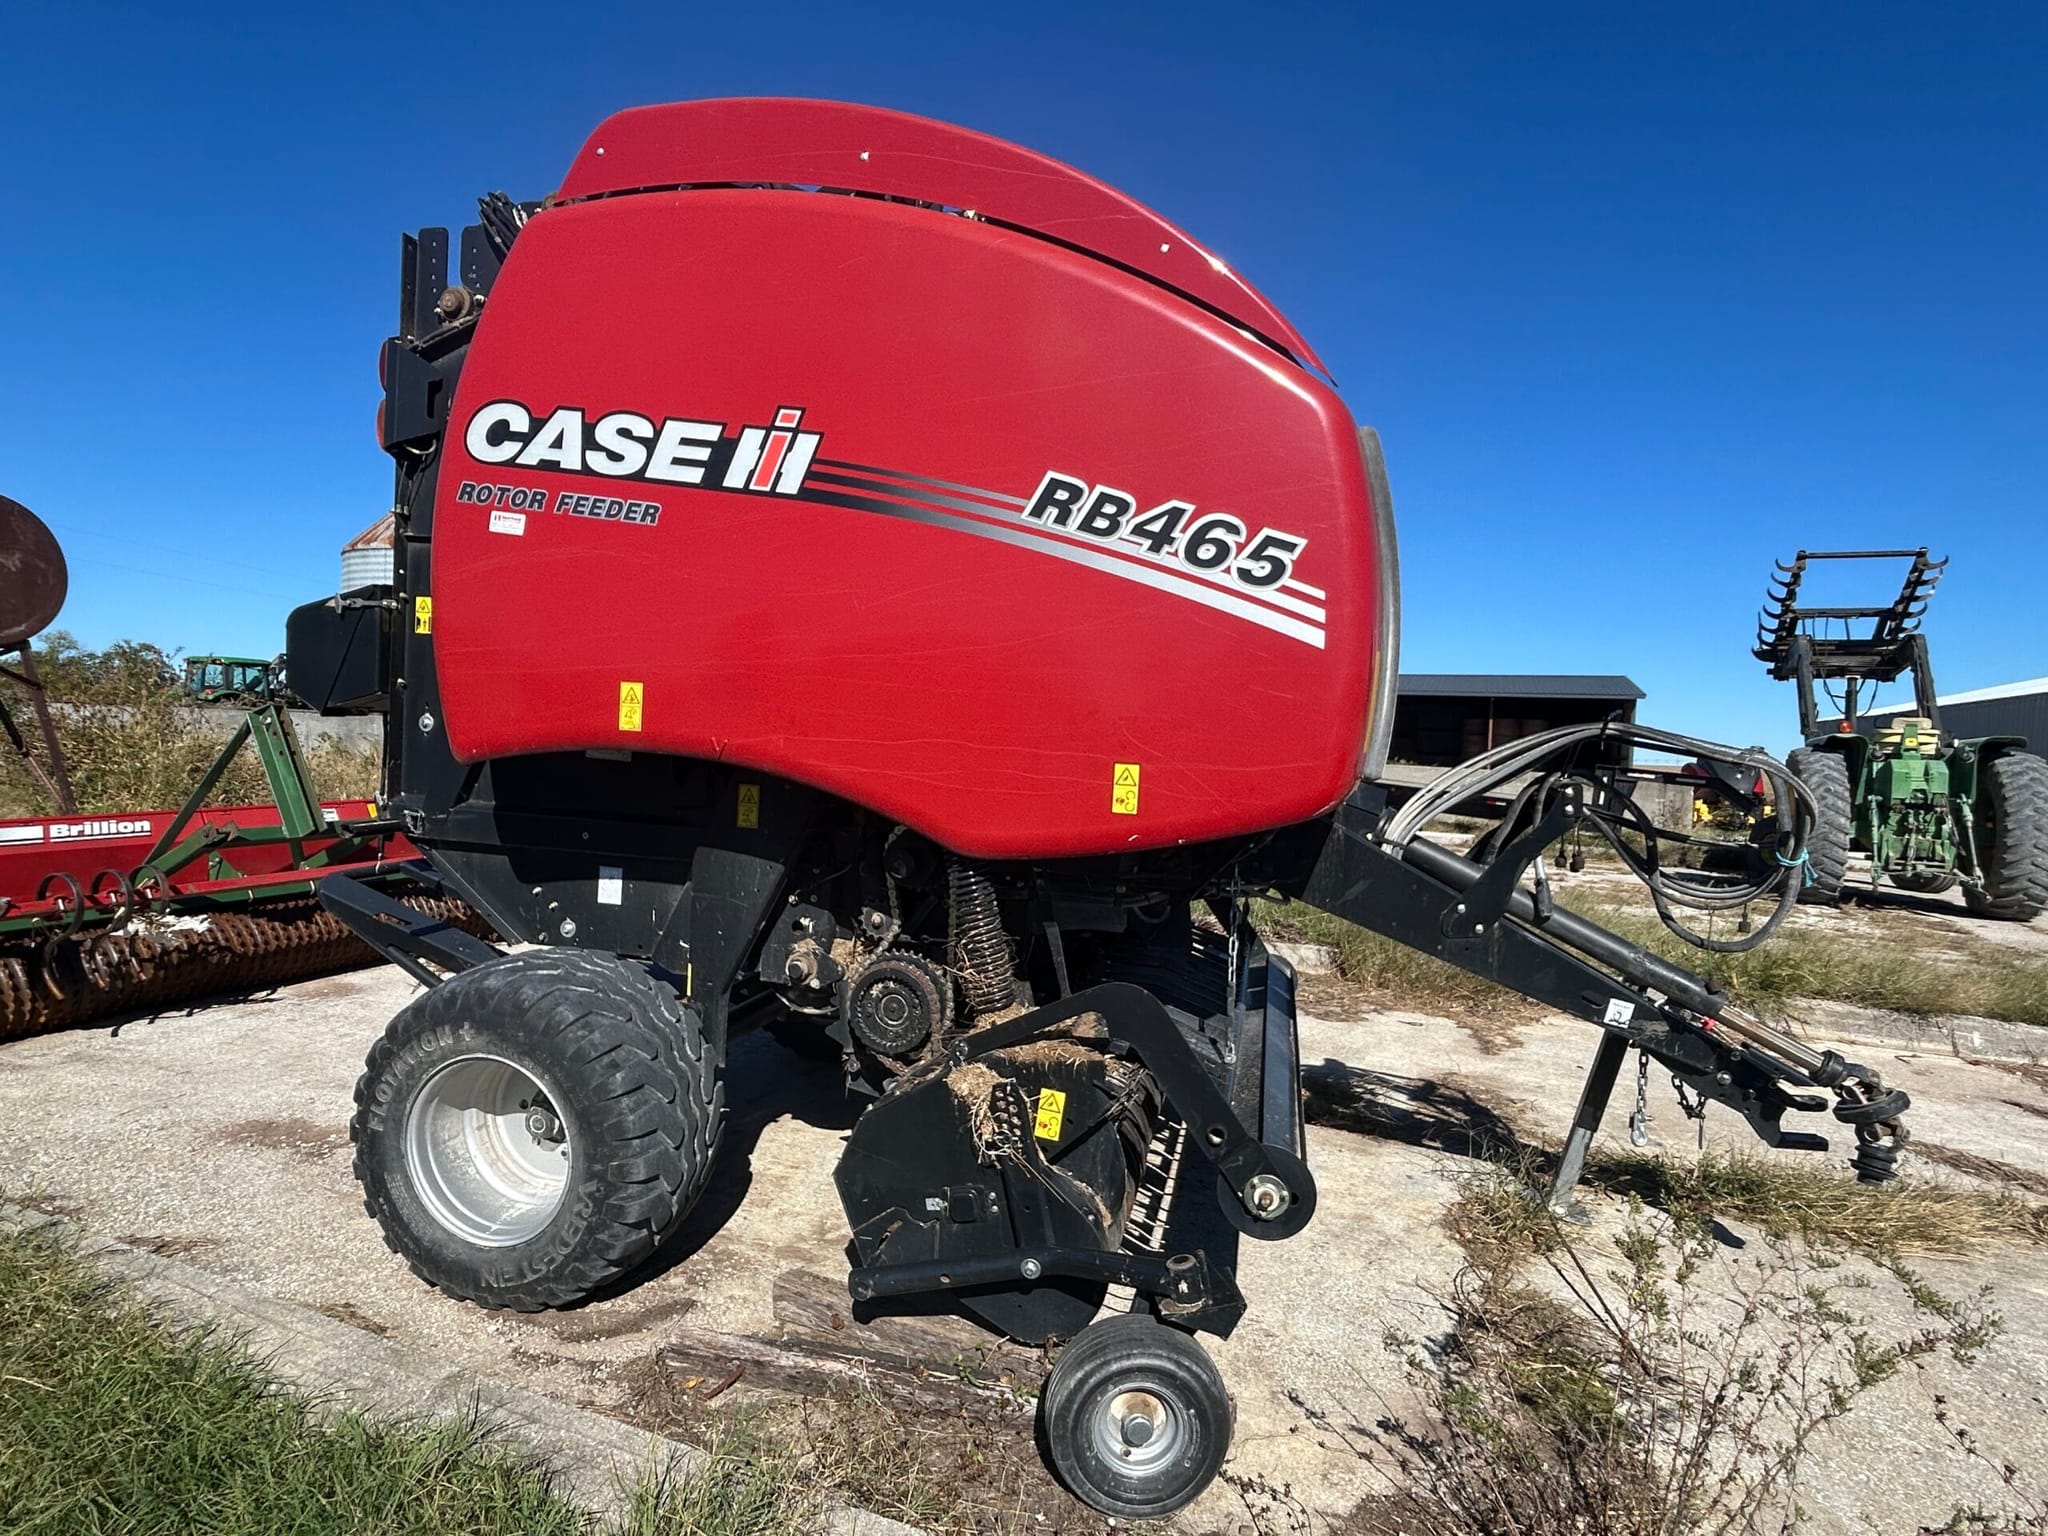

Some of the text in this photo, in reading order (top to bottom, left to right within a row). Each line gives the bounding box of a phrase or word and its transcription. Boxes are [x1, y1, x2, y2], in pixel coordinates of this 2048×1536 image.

[466, 401, 723, 484] CASE
[457, 481, 662, 526] ROTOR FEEDER
[1022, 471, 1308, 590] RB465
[49, 820, 151, 838] Brillion
